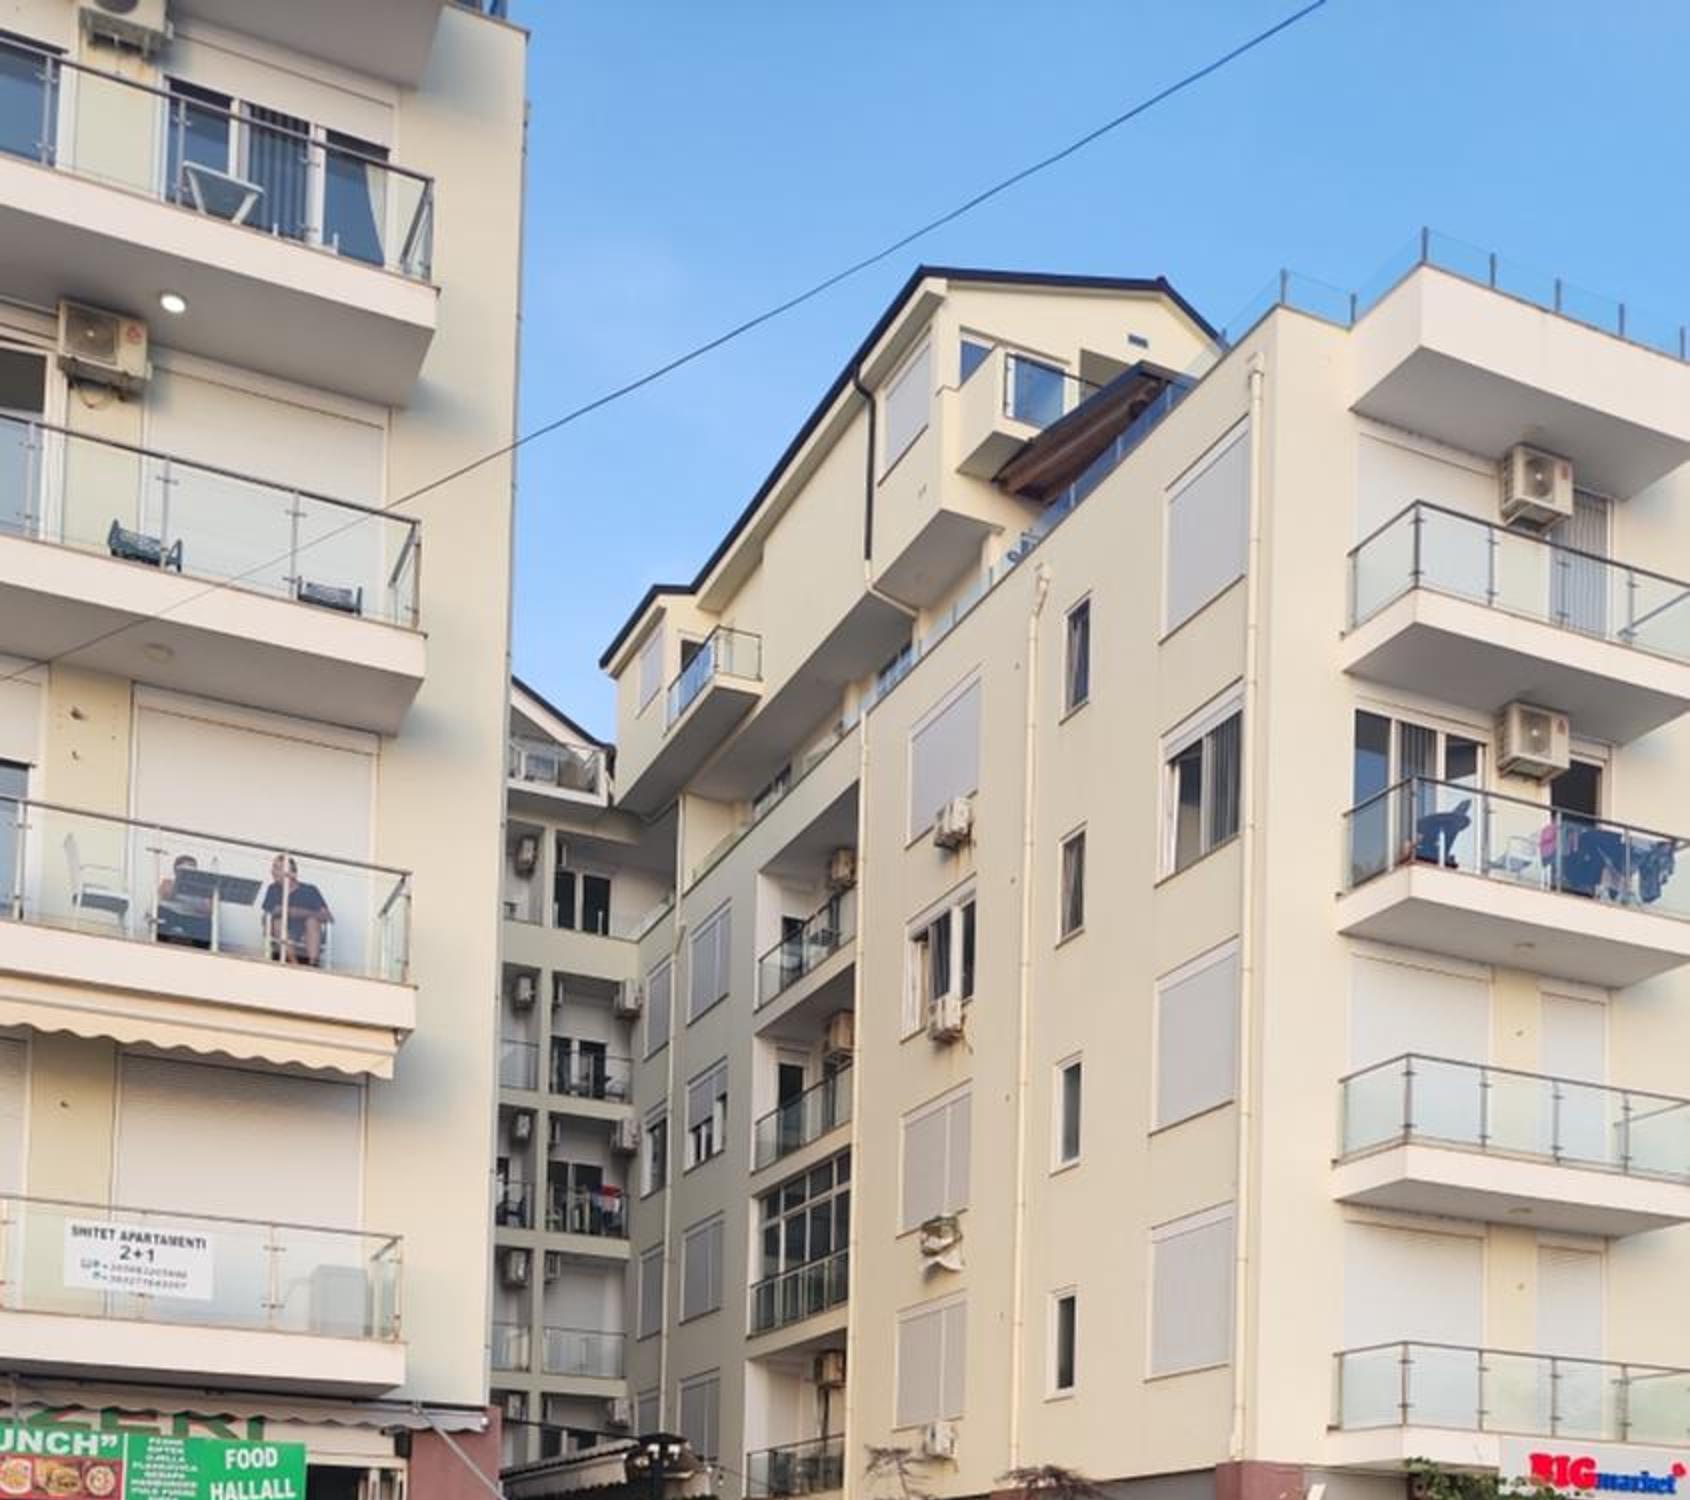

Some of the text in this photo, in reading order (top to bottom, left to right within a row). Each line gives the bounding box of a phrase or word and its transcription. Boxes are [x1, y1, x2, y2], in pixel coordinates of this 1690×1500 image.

[71, 1224, 207, 1250] SHITET APARTAMENTI
[119, 1245, 155, 1263] 2+1
[225, 1446, 278, 1471] FOOD
